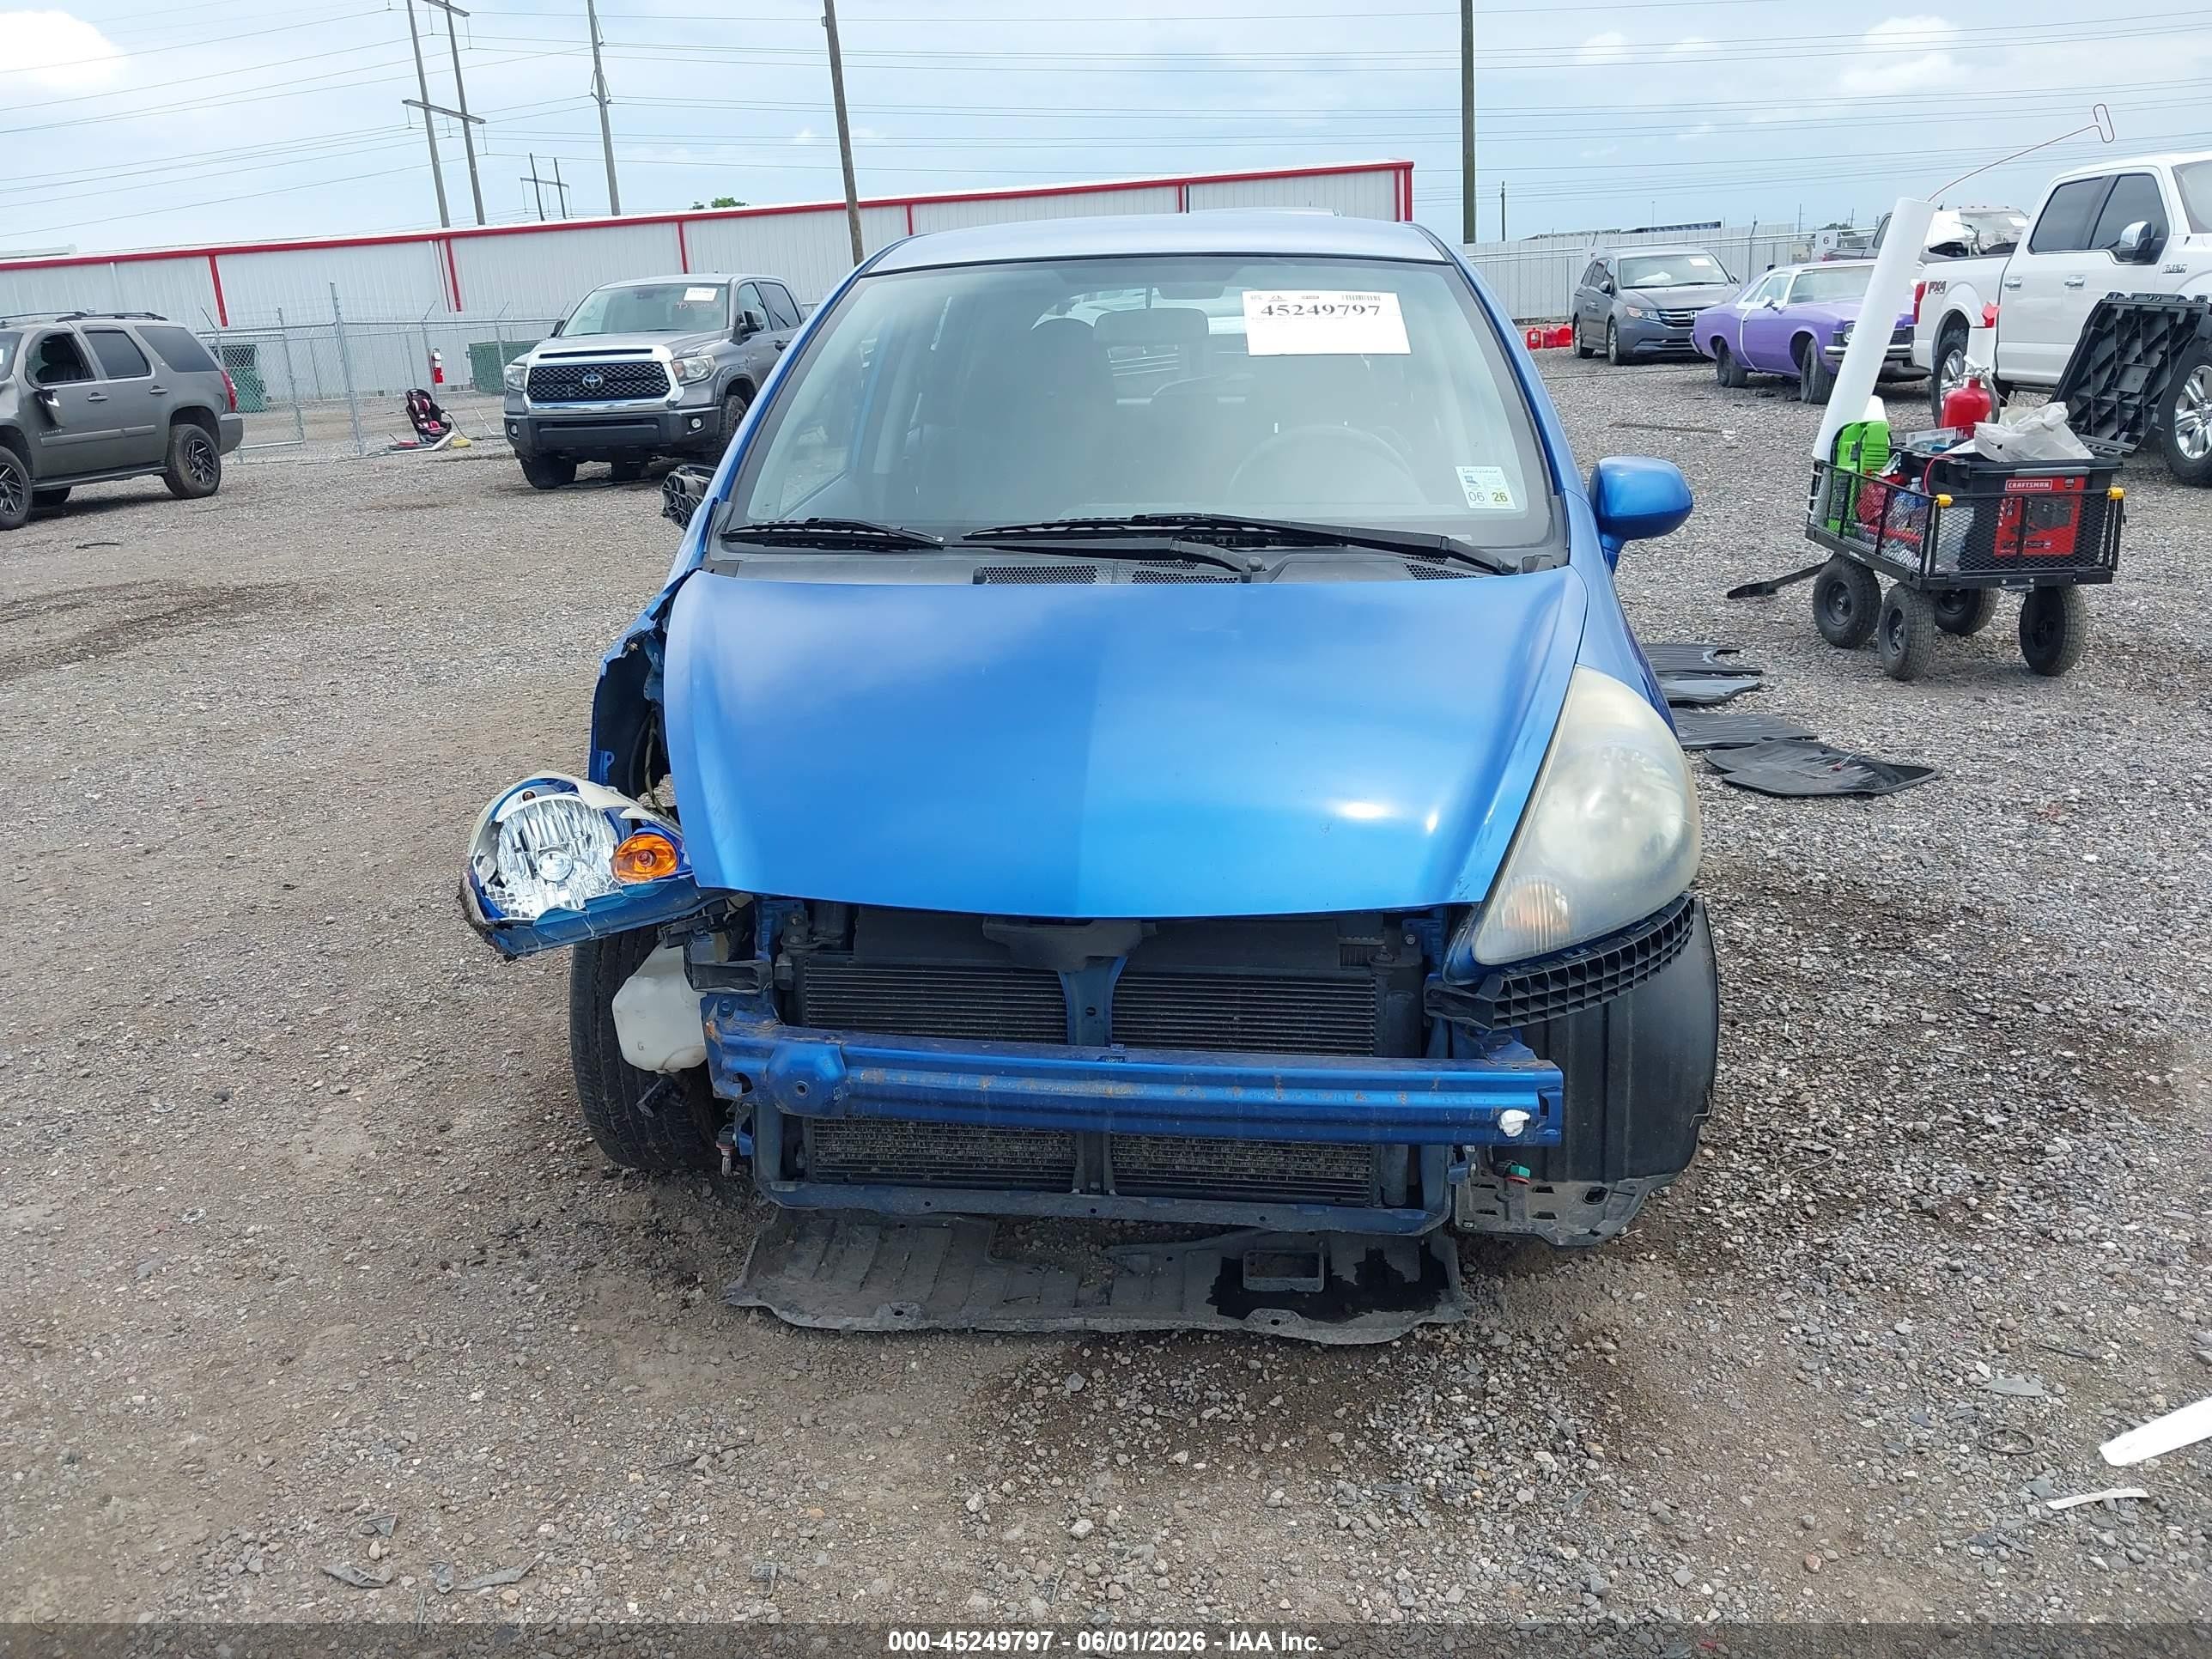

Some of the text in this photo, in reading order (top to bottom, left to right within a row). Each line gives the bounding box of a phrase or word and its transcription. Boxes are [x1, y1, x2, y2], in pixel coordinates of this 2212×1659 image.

[1823, 236, 1829, 245] 6
[1928, 281, 1947, 295] FX4
[1261, 304, 1381, 316] 45249797
[1468, 491, 1508, 502] 06 26
